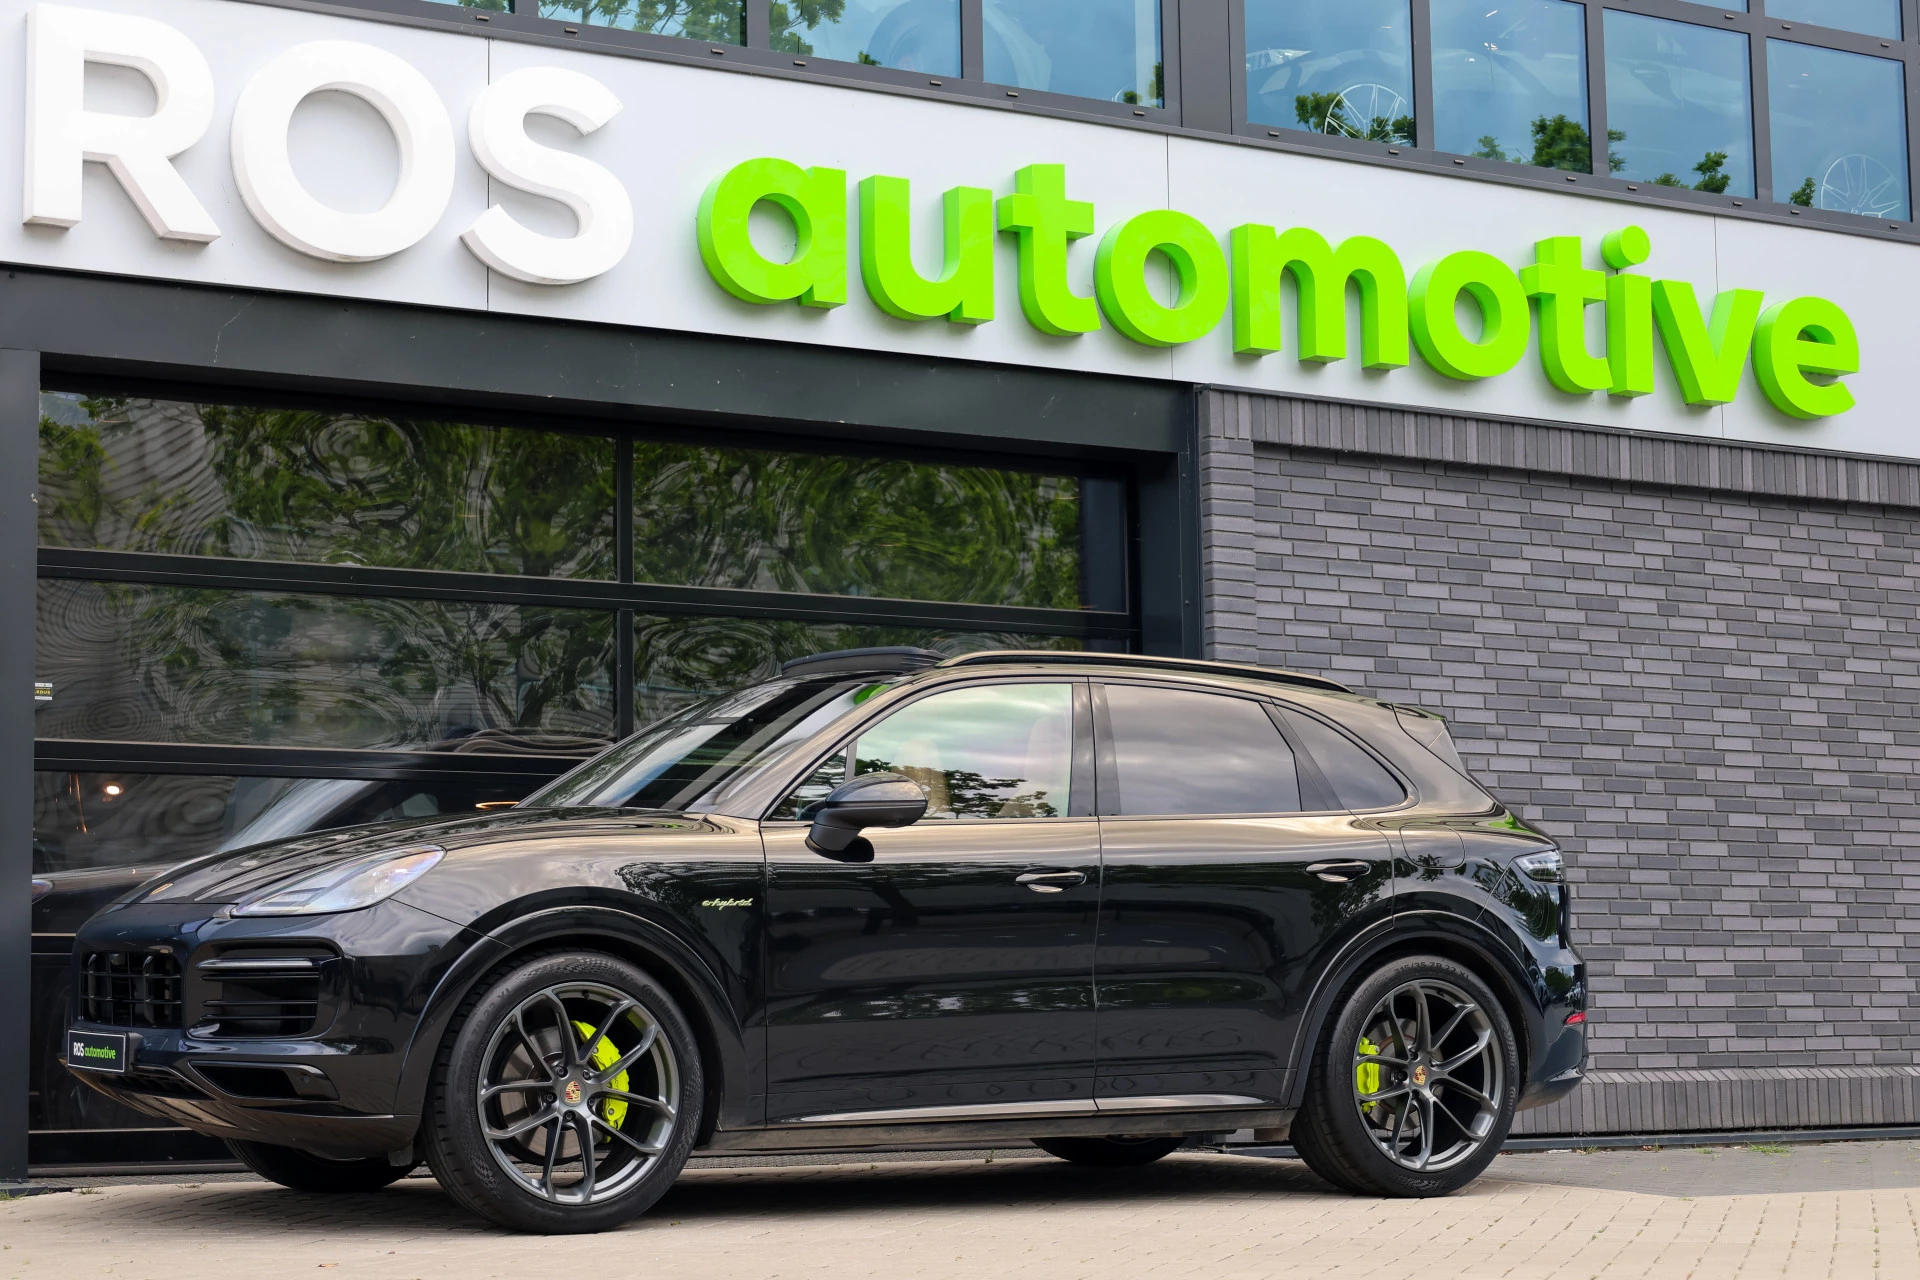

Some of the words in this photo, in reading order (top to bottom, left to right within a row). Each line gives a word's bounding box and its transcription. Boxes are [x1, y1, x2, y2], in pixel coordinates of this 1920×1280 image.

[22, 4, 634, 285] ROS
[696, 156, 1860, 420] automotive
[73, 1042, 84, 1056] ROS
[84, 1045, 116, 1059] automotive
